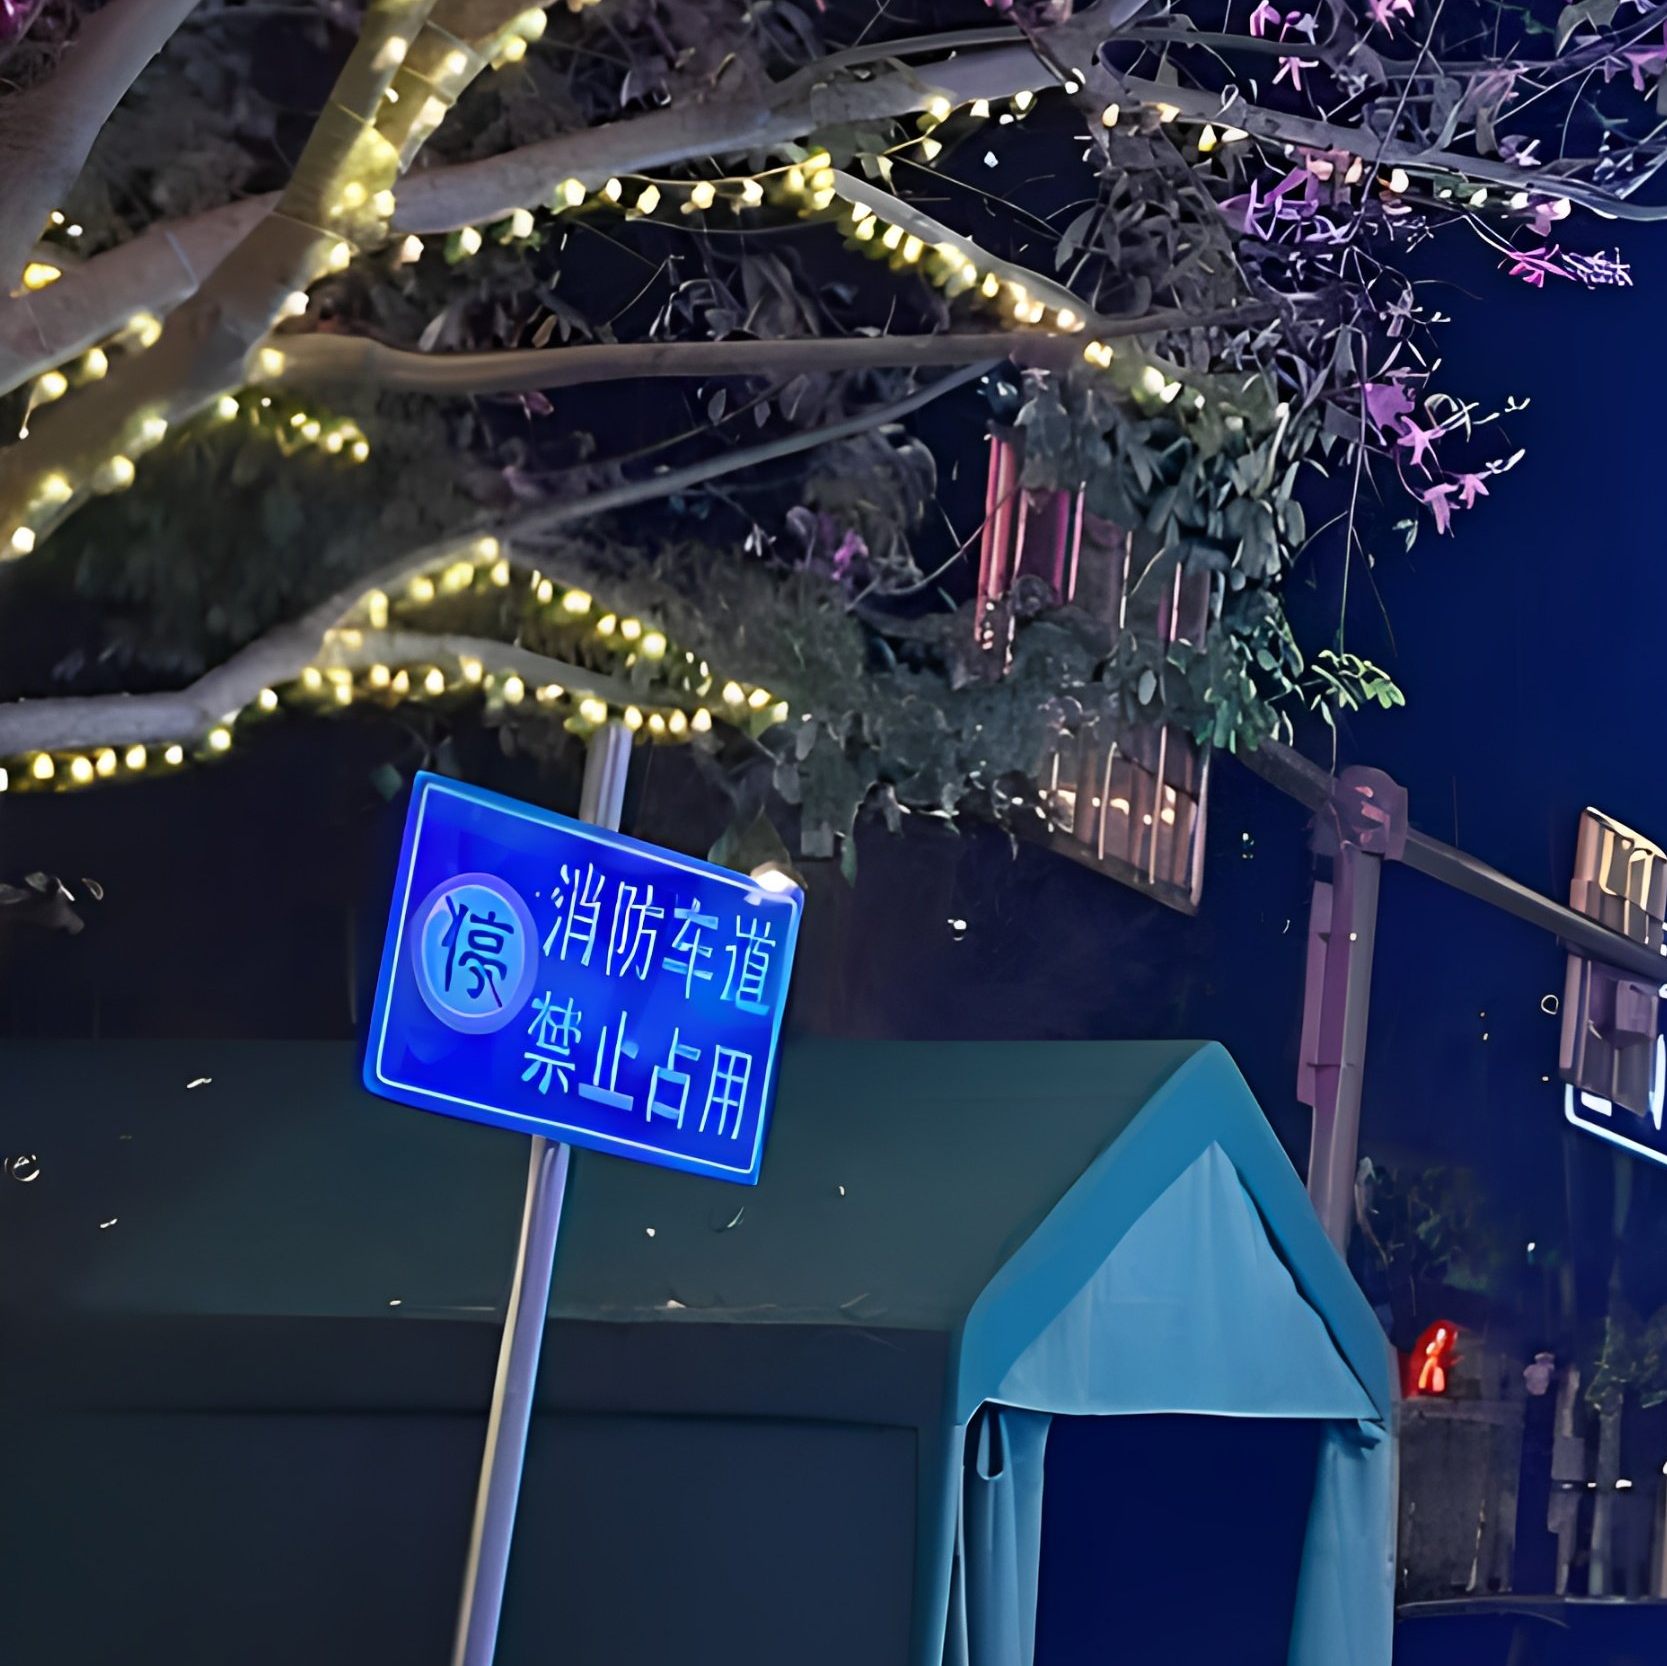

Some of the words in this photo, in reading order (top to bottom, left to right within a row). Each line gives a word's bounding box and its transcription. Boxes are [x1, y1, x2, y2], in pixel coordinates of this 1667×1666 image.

[542, 863, 776, 1014] 消防车道
[521, 990, 752, 1139] 禁止占用
